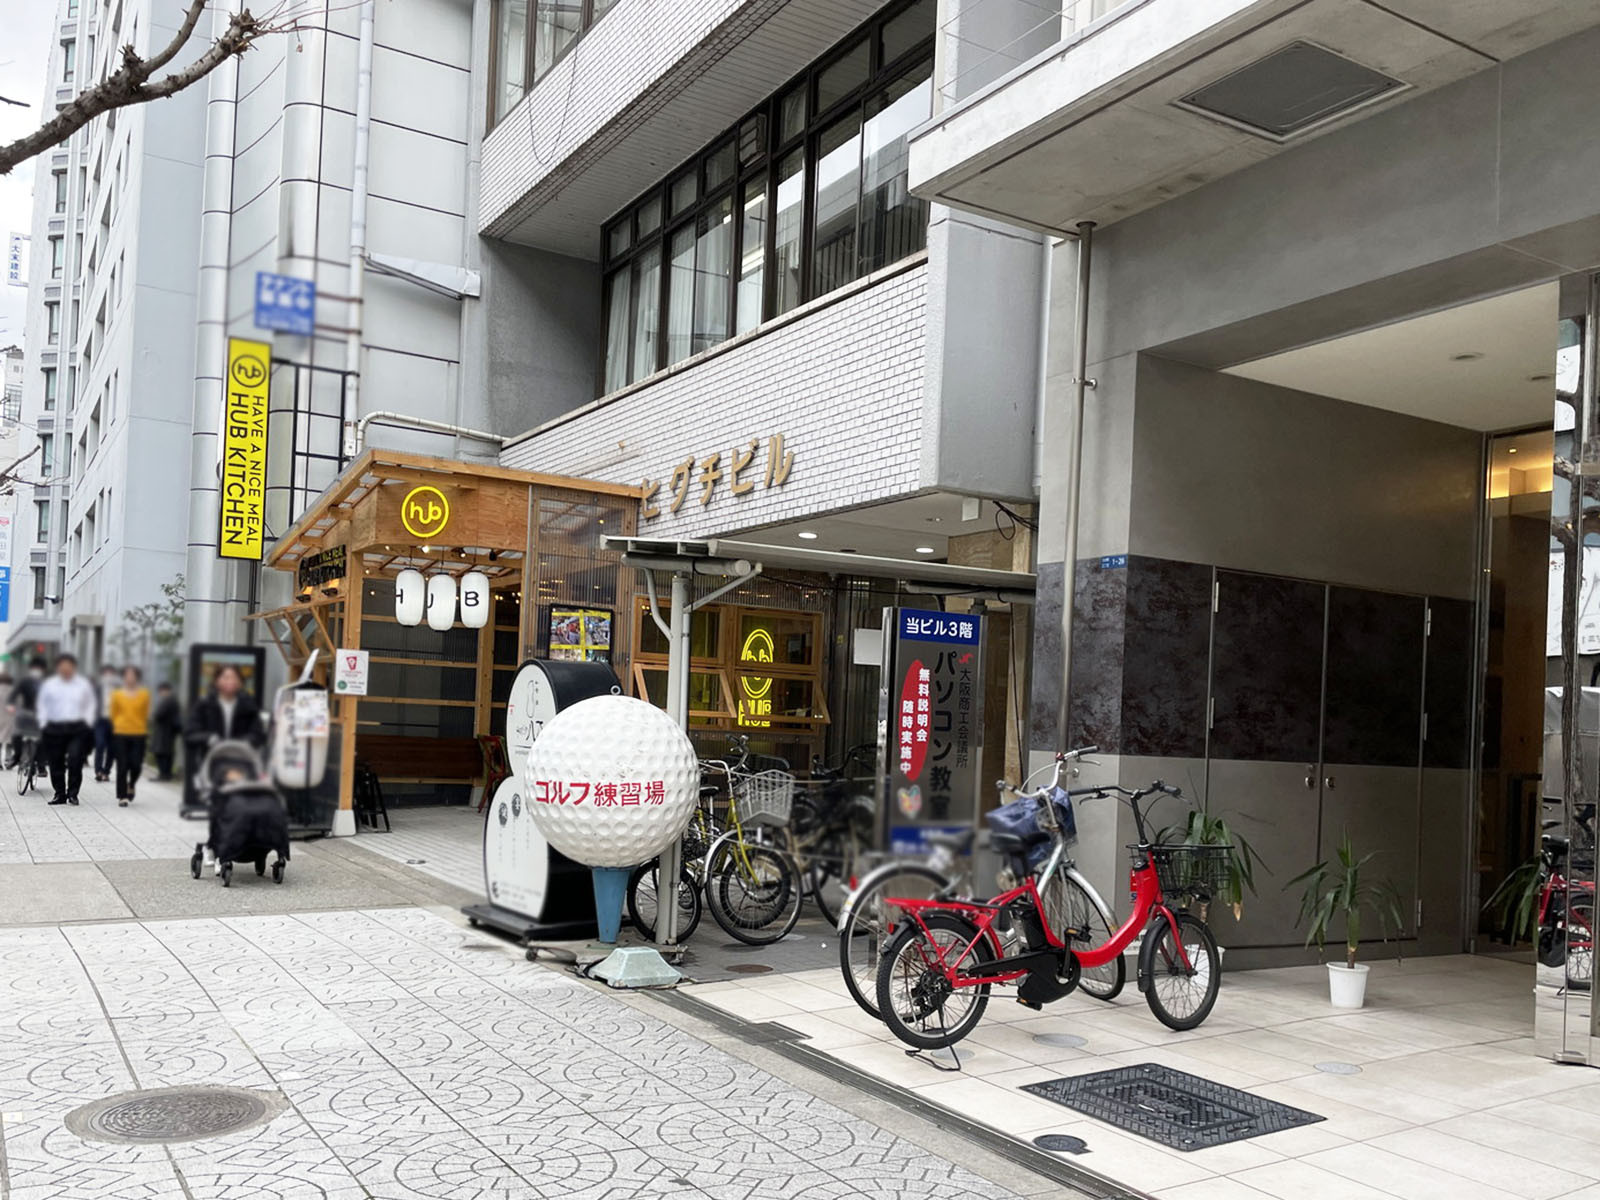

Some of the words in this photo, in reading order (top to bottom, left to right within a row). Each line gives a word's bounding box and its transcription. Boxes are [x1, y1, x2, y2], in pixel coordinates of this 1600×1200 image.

[229, 392, 249, 439] HUB
[251, 395, 264, 438] HAVE
[250, 443, 262, 453] A
[225, 446, 247, 545] KITCHEN
[248, 460, 261, 497] NICE
[246, 503, 259, 545] MEAL
[410, 501, 442, 524] hub
[906, 617, 973, 639] 当ビル3階
[916, 668, 930, 742] 無料説明会
[900, 700, 914, 774] 随時実施中
[535, 780, 665, 807] ゴルフ練習場
